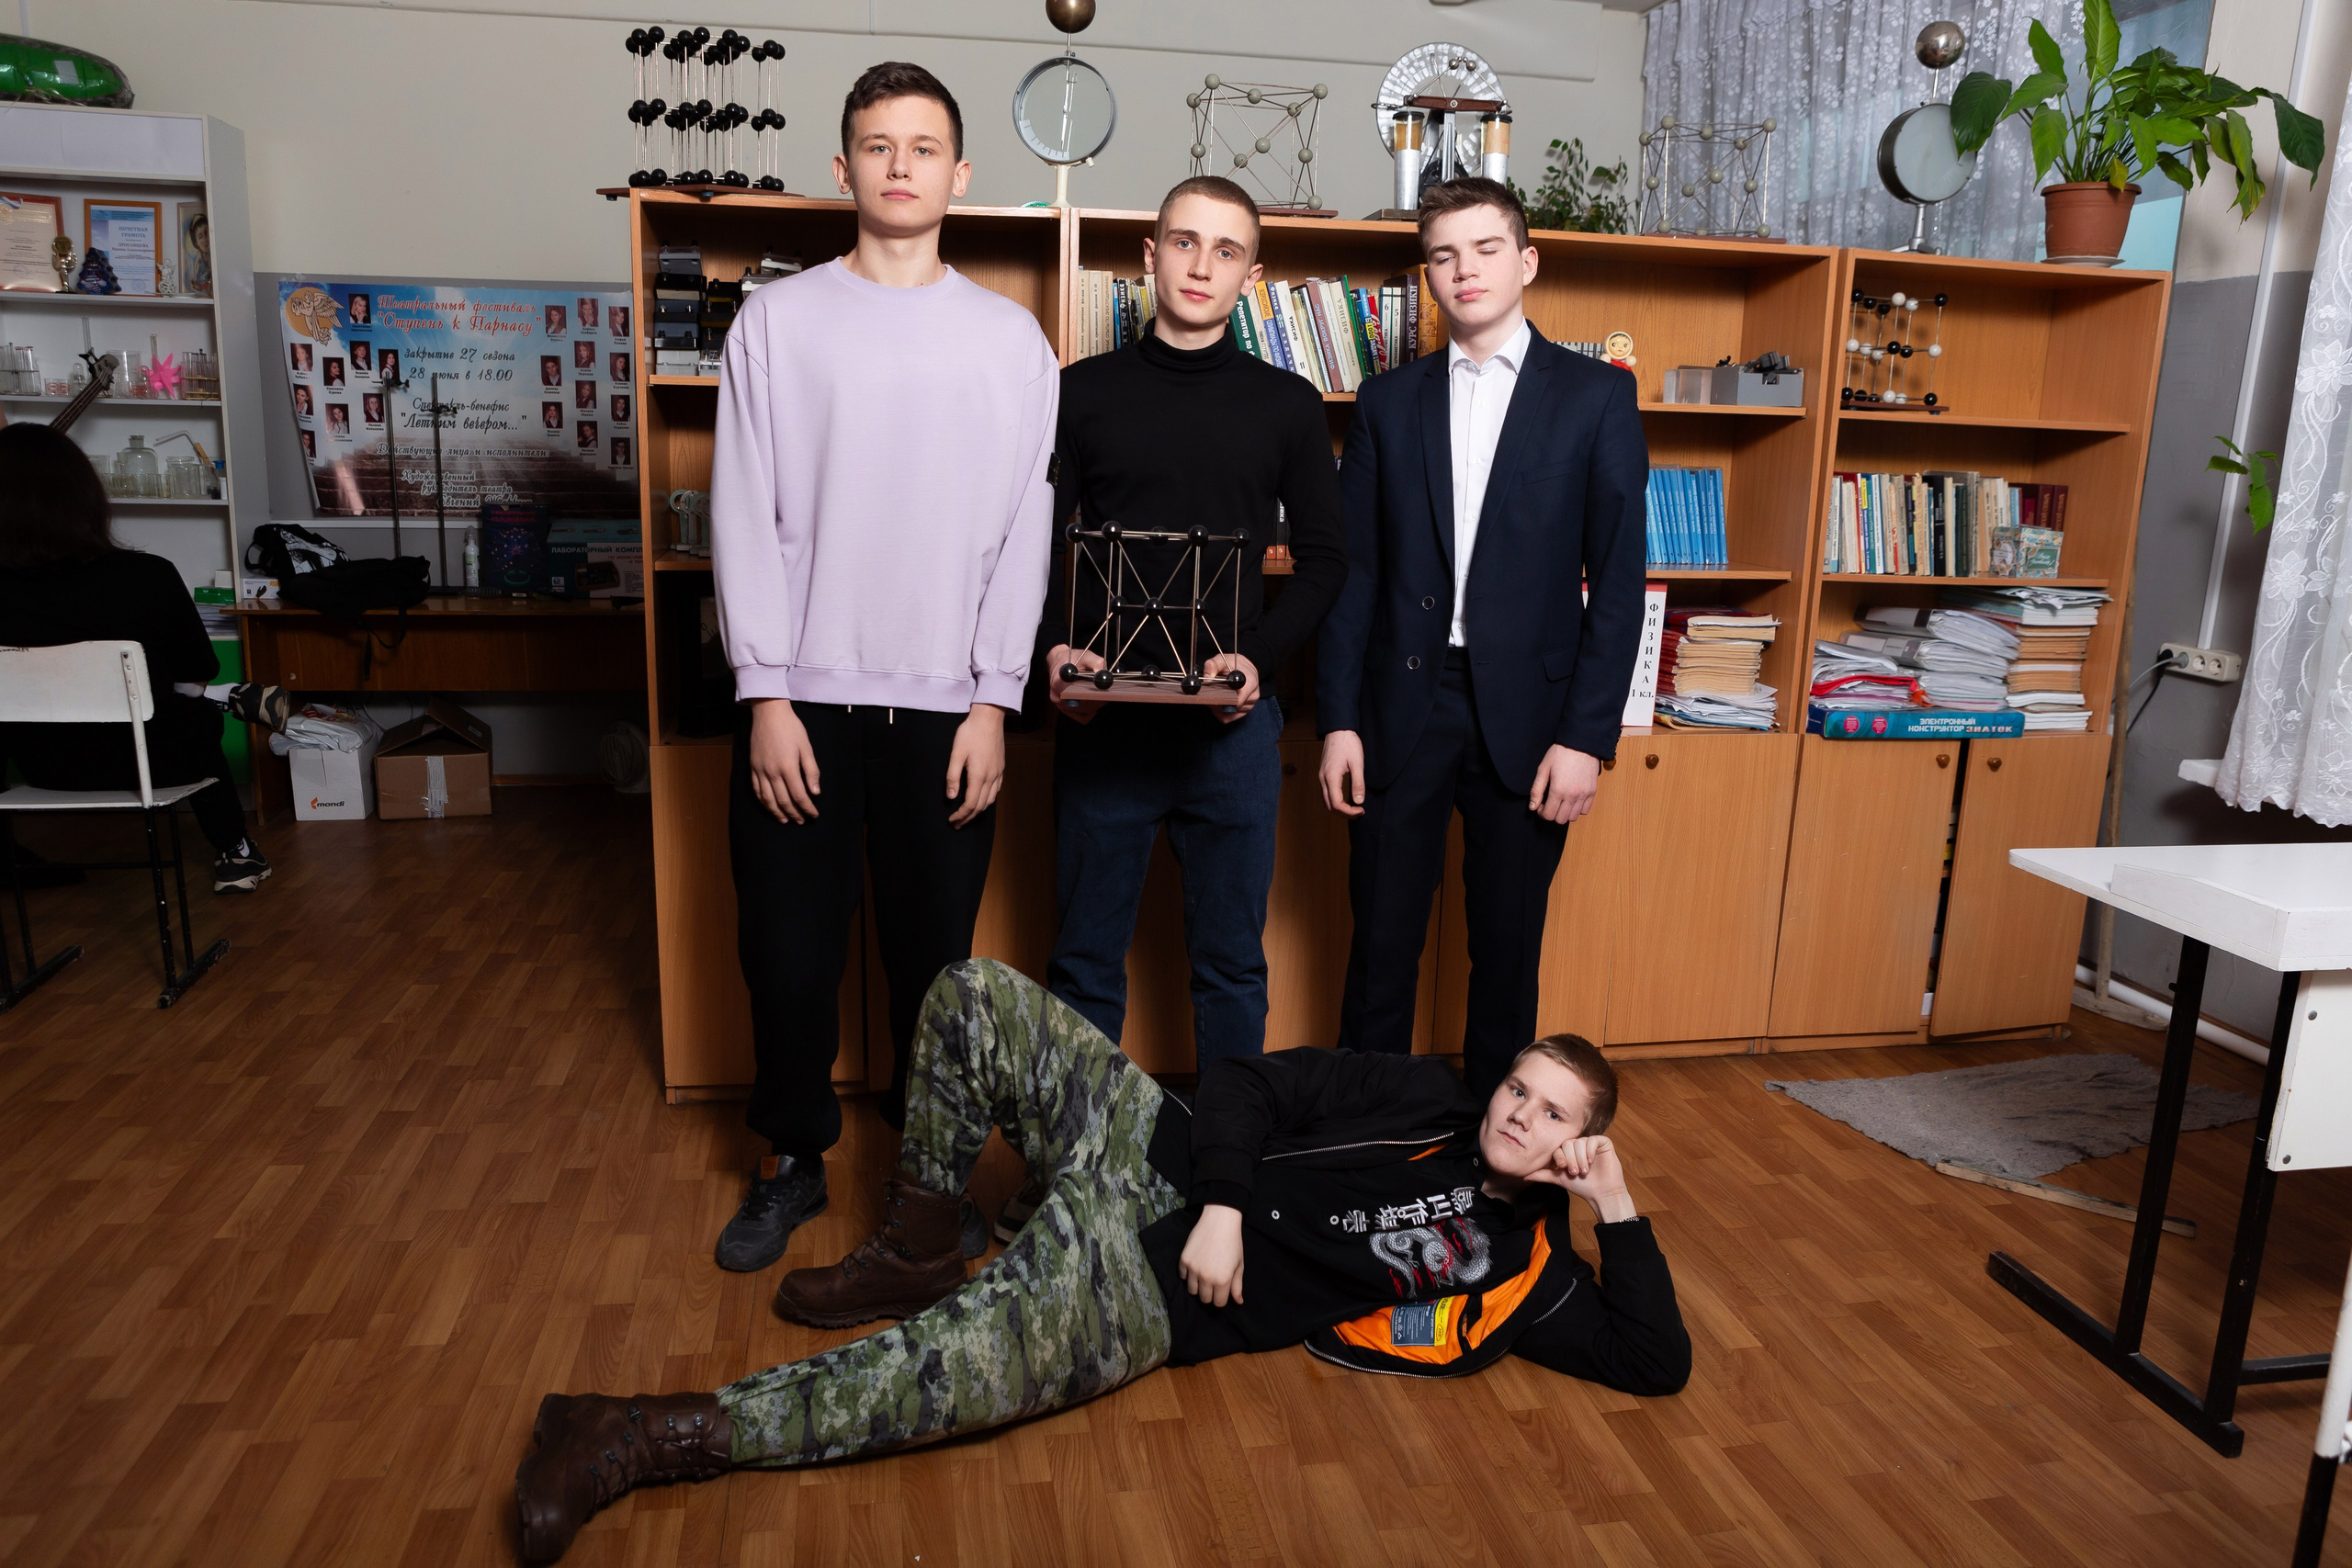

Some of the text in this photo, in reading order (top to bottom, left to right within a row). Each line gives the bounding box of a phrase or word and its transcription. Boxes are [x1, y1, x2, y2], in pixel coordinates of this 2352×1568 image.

[378, 295, 536, 315] Театральный фестиваль
[1409, 285, 1418, 323] ФИЗИКИ
[1236, 301, 1250, 338] Репетитор
[1245, 340, 1254, 349] по
[1337, 298, 1349, 333] ФИЗИКА
[1289, 316, 1298, 341] ФИЗИКА
[1318, 319, 1329, 342] ВОКРУГ
[404, 346, 515, 364] закрытие 27 сезона
[1326, 344, 1335, 370] ФИЗИКА
[409, 367, 425, 378] 28
[466, 370, 470, 379] в
[478, 369, 513, 381] 18.00
[447, 448, 469, 457] лица
[486, 448, 551, 457] исполнители:
[480, 481, 513, 495] театра
[1642, 604, 1659, 683] ФИЗИКА
[1908, 724, 1964, 733] КОНСТРУКТОР
[1919, 716, 1976, 726] ЭЛЕКТРОННЫЙ
[317, 799, 345, 807] mondi
